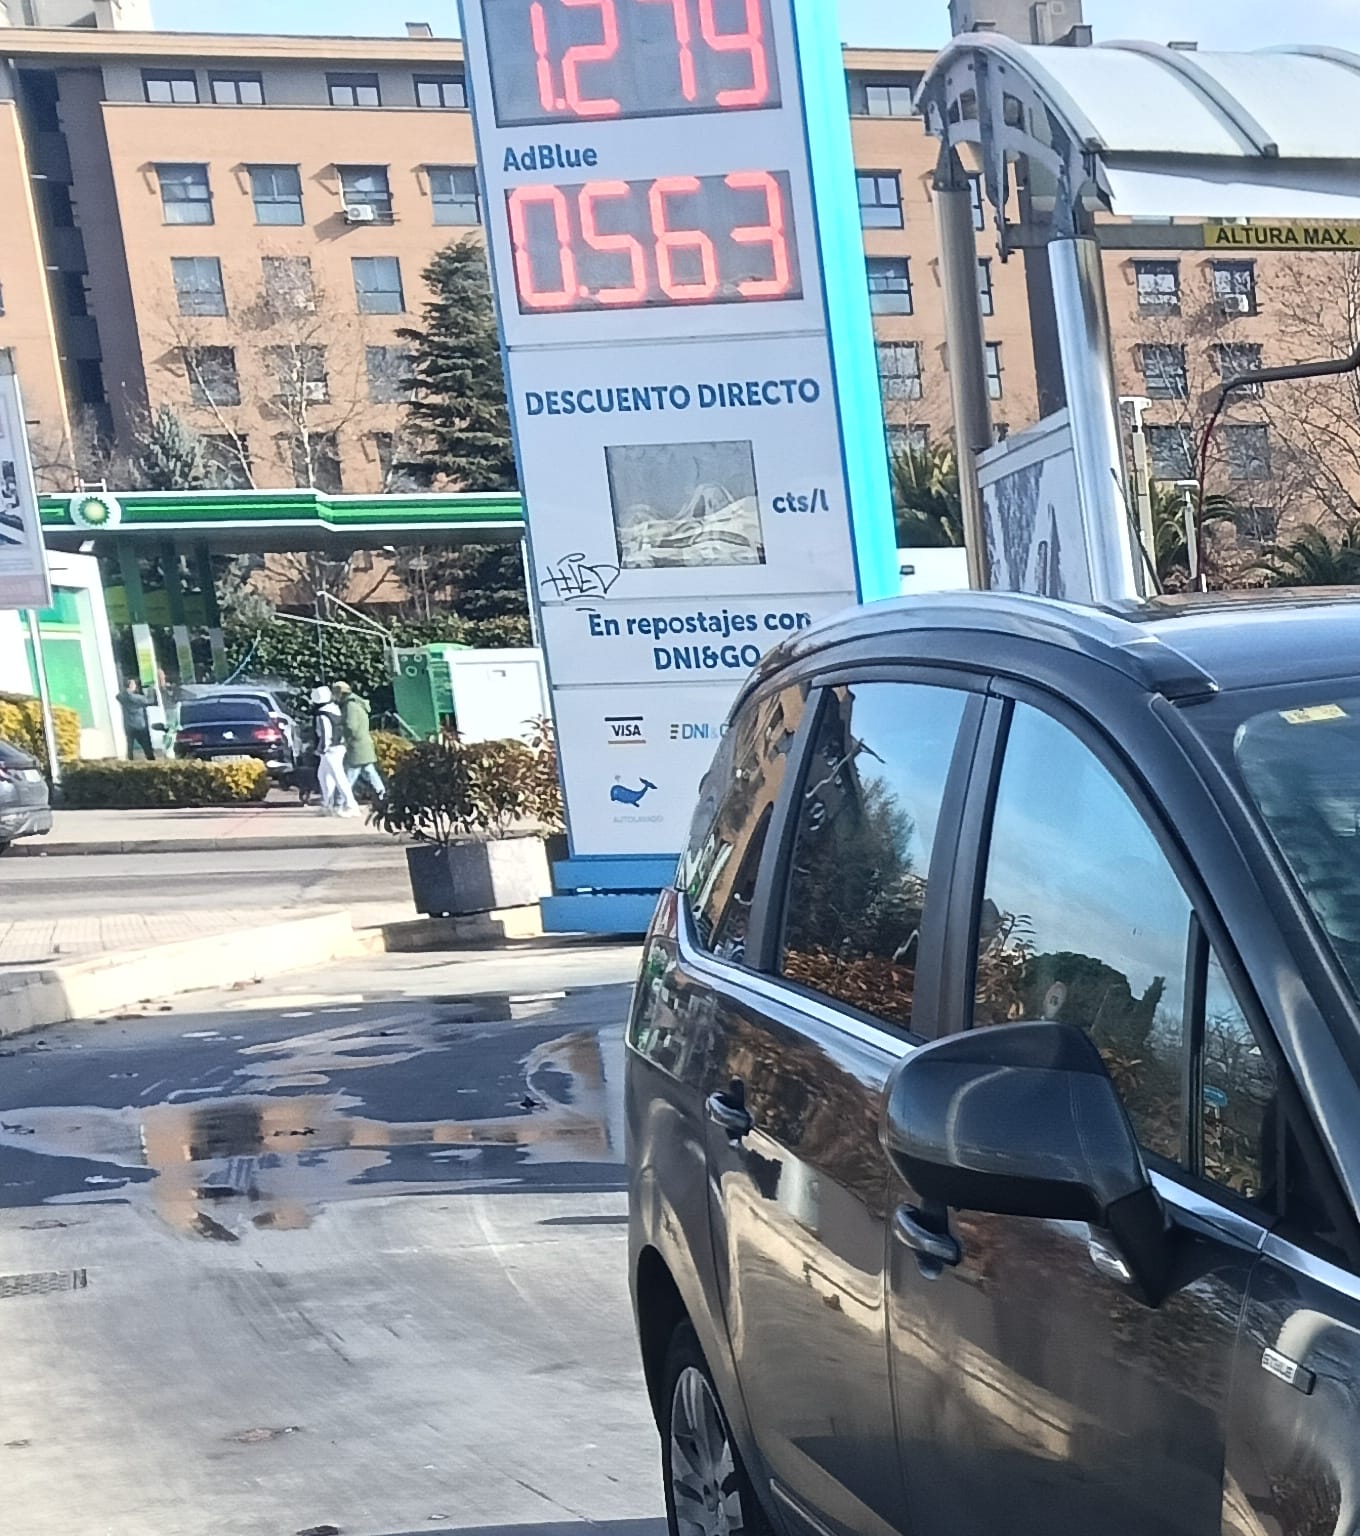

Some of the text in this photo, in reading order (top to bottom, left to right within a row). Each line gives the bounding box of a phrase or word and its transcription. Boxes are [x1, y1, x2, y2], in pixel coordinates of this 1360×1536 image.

[503, 145, 598, 172] AdBlue
[1215, 227, 1299, 244] ALTURA
[1303, 228, 1353, 245] MAX.
[525, 378, 820, 416] DESCUENTO DIRECTO
[772, 487, 829, 514] cts/l
[588, 609, 812, 640] En repostajes con
[653, 644, 761, 671] DNI&GO
[611, 724, 642, 737] VISA
